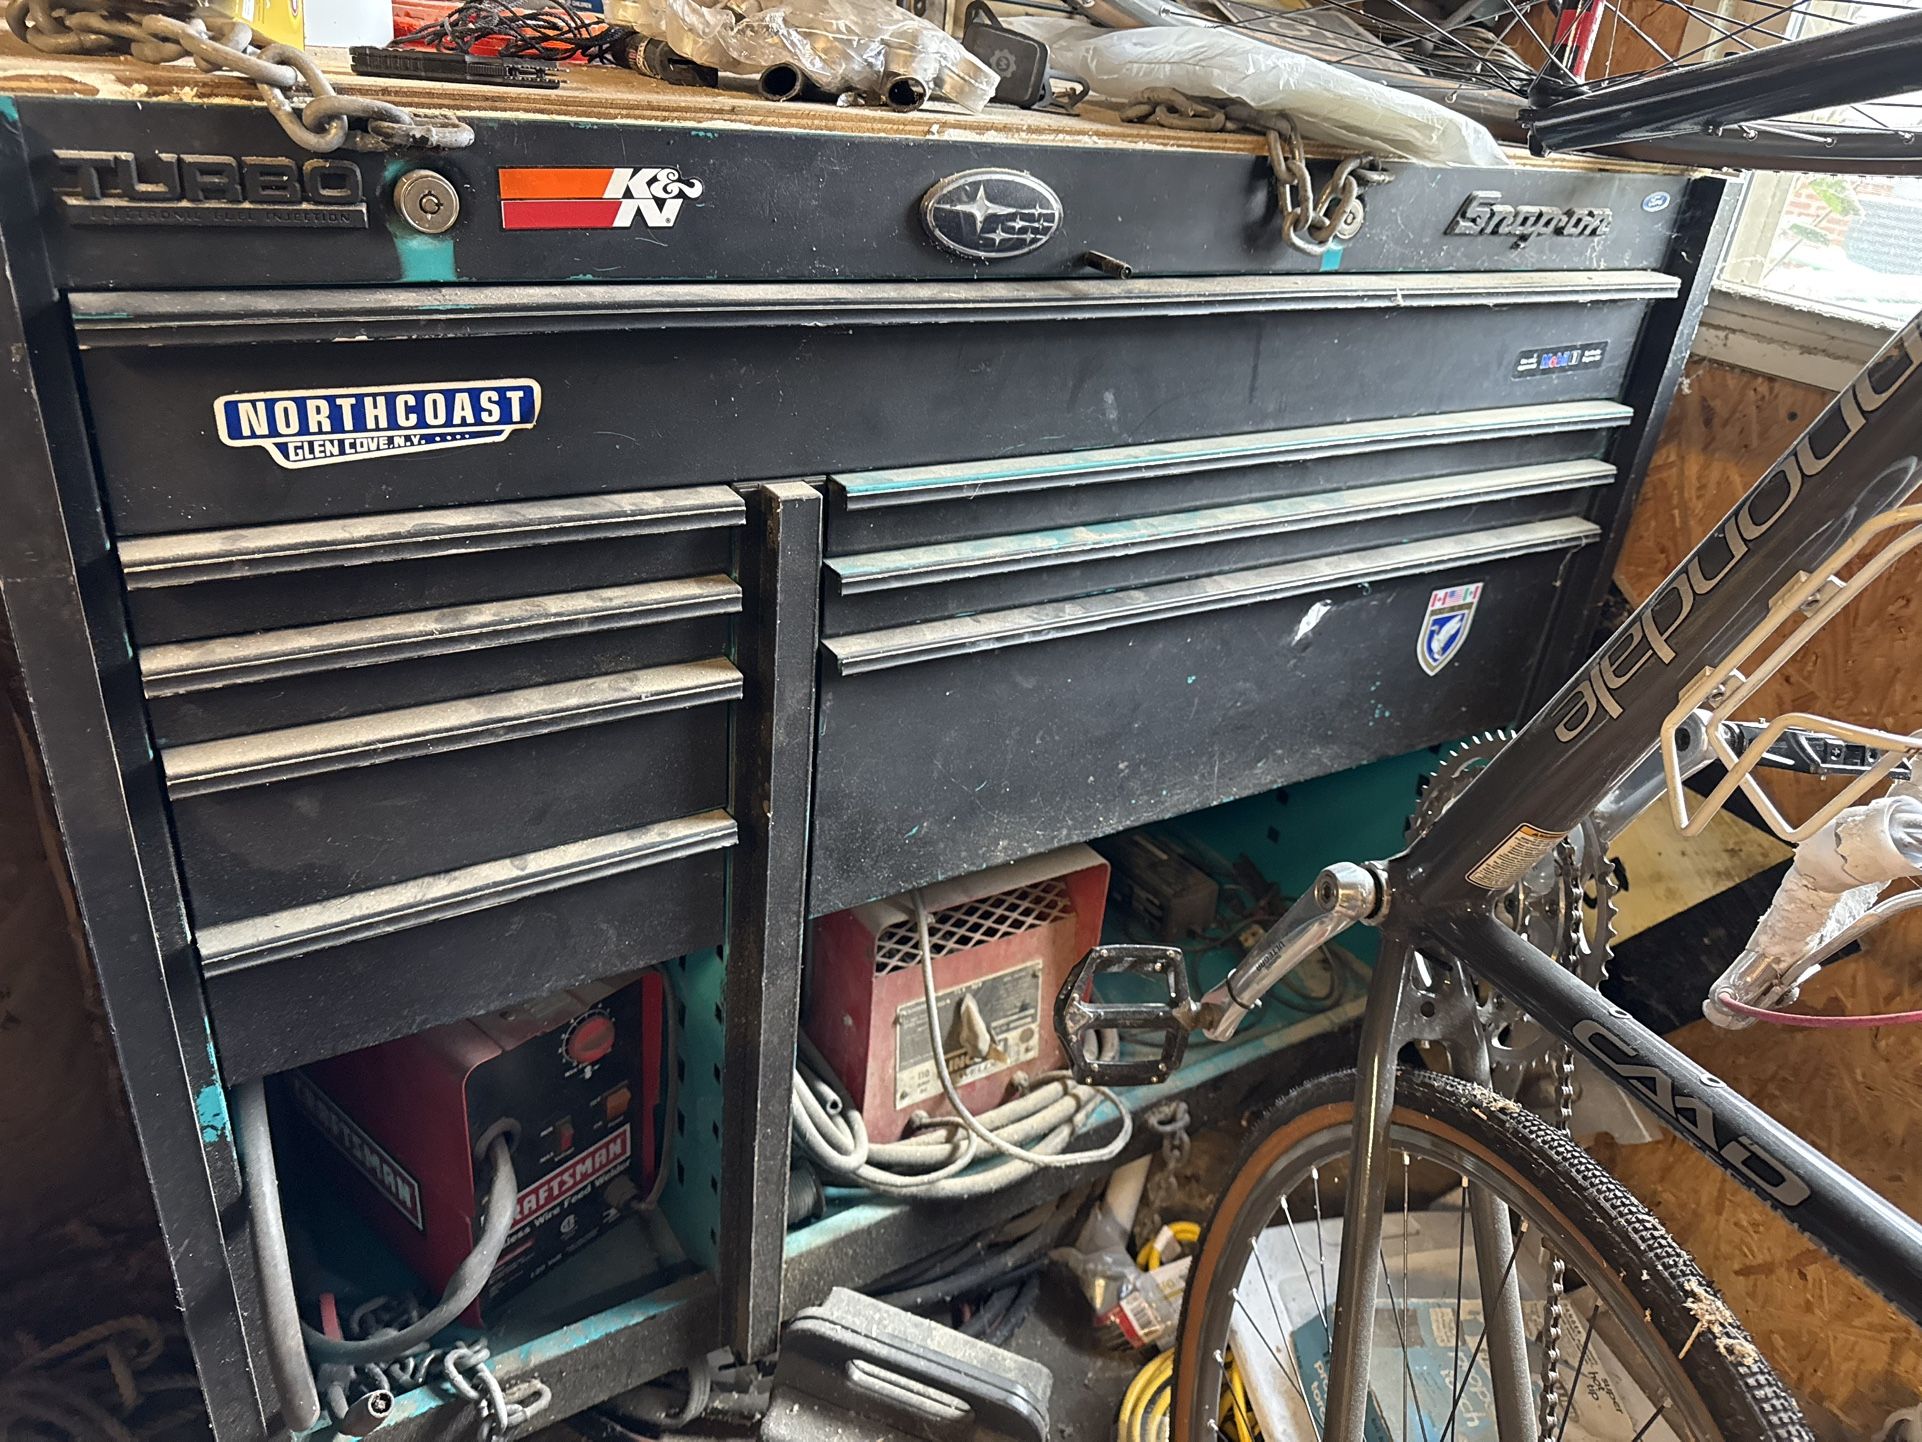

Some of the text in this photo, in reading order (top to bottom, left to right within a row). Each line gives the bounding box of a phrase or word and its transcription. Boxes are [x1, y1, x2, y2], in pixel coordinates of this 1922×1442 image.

[52, 150, 364, 202] TURBO
[237, 390, 525, 437] NORTHCOAST
[288, 438, 346, 462] GLEN
[1552, 322, 1922, 743] nnondale
[514, 1139, 623, 1221] RAFTSMAN
[1586, 1384, 1600, 1402] tip
[1587, 1371, 1606, 1392] hot
[1601, 1377, 1624, 1415] super
